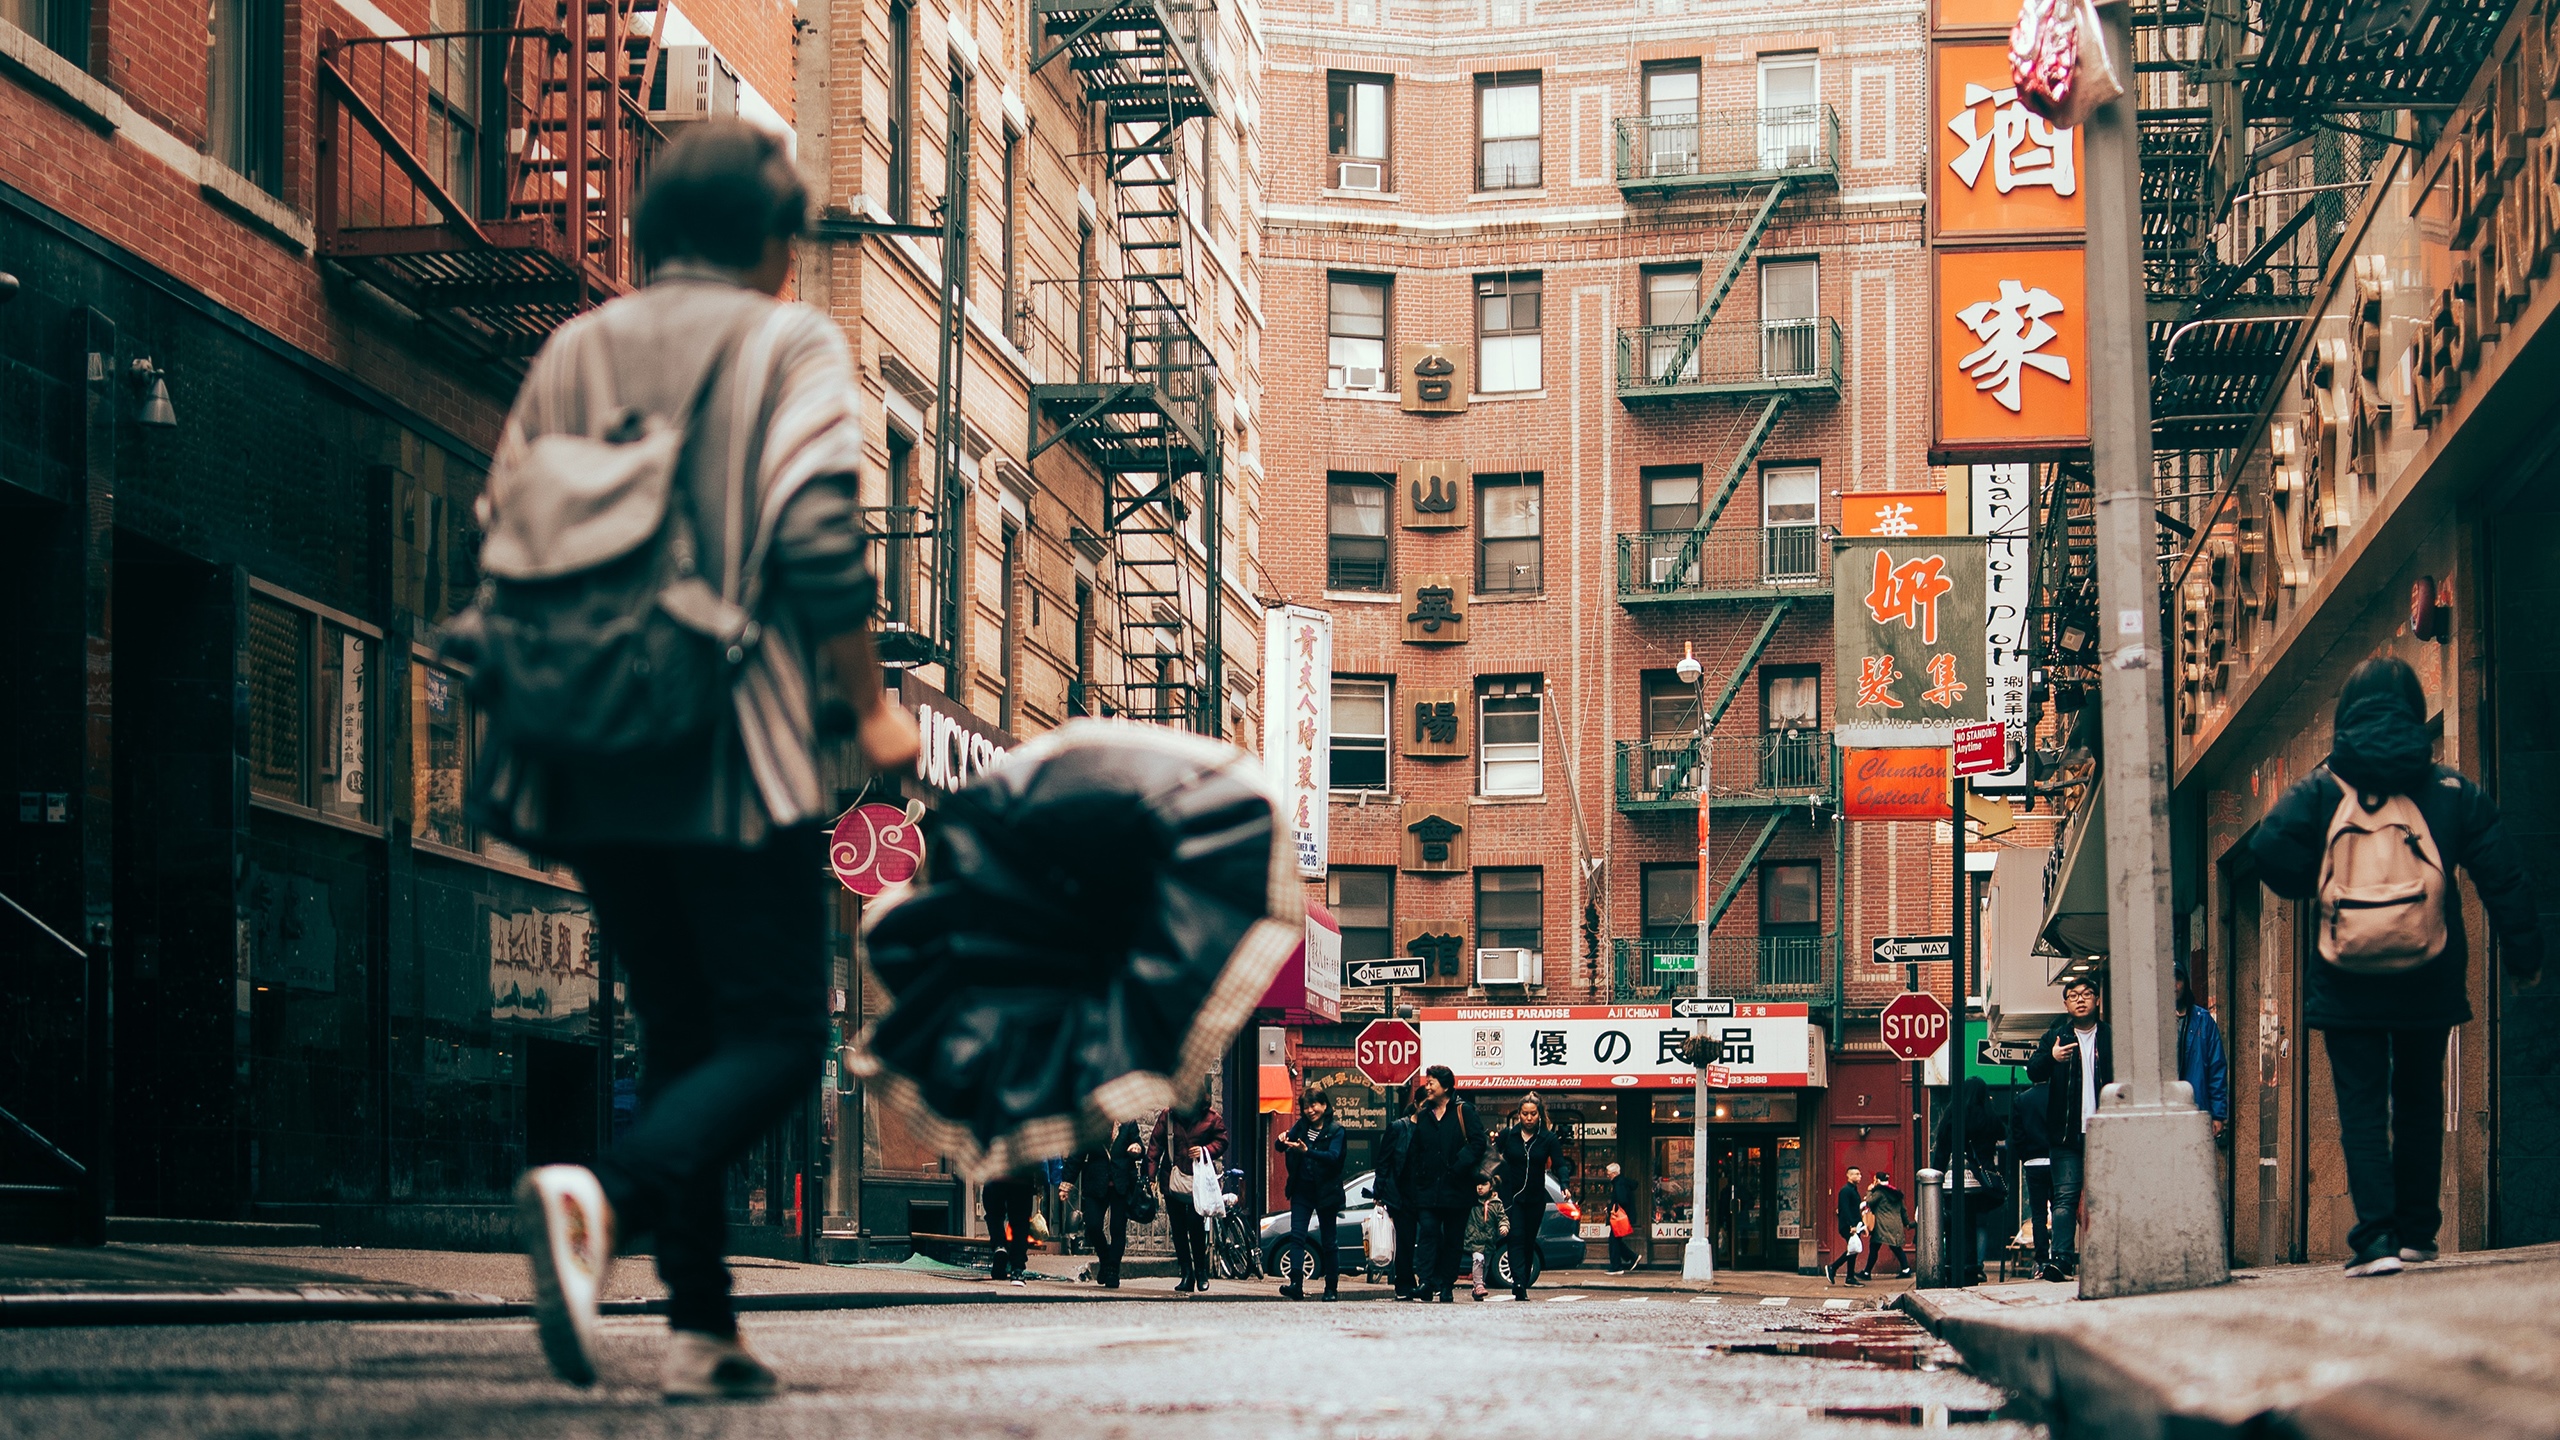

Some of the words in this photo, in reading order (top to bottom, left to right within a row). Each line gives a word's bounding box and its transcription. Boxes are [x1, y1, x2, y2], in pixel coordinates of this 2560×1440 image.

[1947, 82, 2077, 412] 酒家
[1988, 464, 2016, 518] uan
[1956, 732, 1966, 743] NO
[1967, 727, 1997, 741] STANDING
[917, 704, 969, 794] JUICY
[1957, 742, 1982, 754] Anytime
[1857, 785, 1931, 810] Optical
[1883, 945, 1907, 955] ONE
[1921, 943, 1946, 954] WAY
[1661, 956, 1680, 965] MOTT
[1360, 968, 1382, 979] ONE
[1393, 966, 1415, 977] WAY
[1457, 1009, 1514, 1019] MUNCHIES
[1517, 1009, 1570, 1019] PARADISE
[1608, 1008, 1622, 1018] AJI
[1625, 1007, 1659, 1018] ICHIBAN
[1681, 1005, 1698, 1013] ONE
[1707, 1004, 1726, 1012] WAY
[1886, 1014, 1945, 1039] STOP
[1360, 1040, 1418, 1065] STOP
[1992, 1049, 2012, 1058] ONE
[1670, 1076, 1683, 1085] Toll
[1730, 1076, 1767, 1084] 33-3888
[1336, 1097, 1360, 1106] 33-37
[1344, 1108, 1359, 1118] Yung
[1364, 1119, 1377, 1128] Inc.
[1657, 1227, 1672, 1236] AJI
